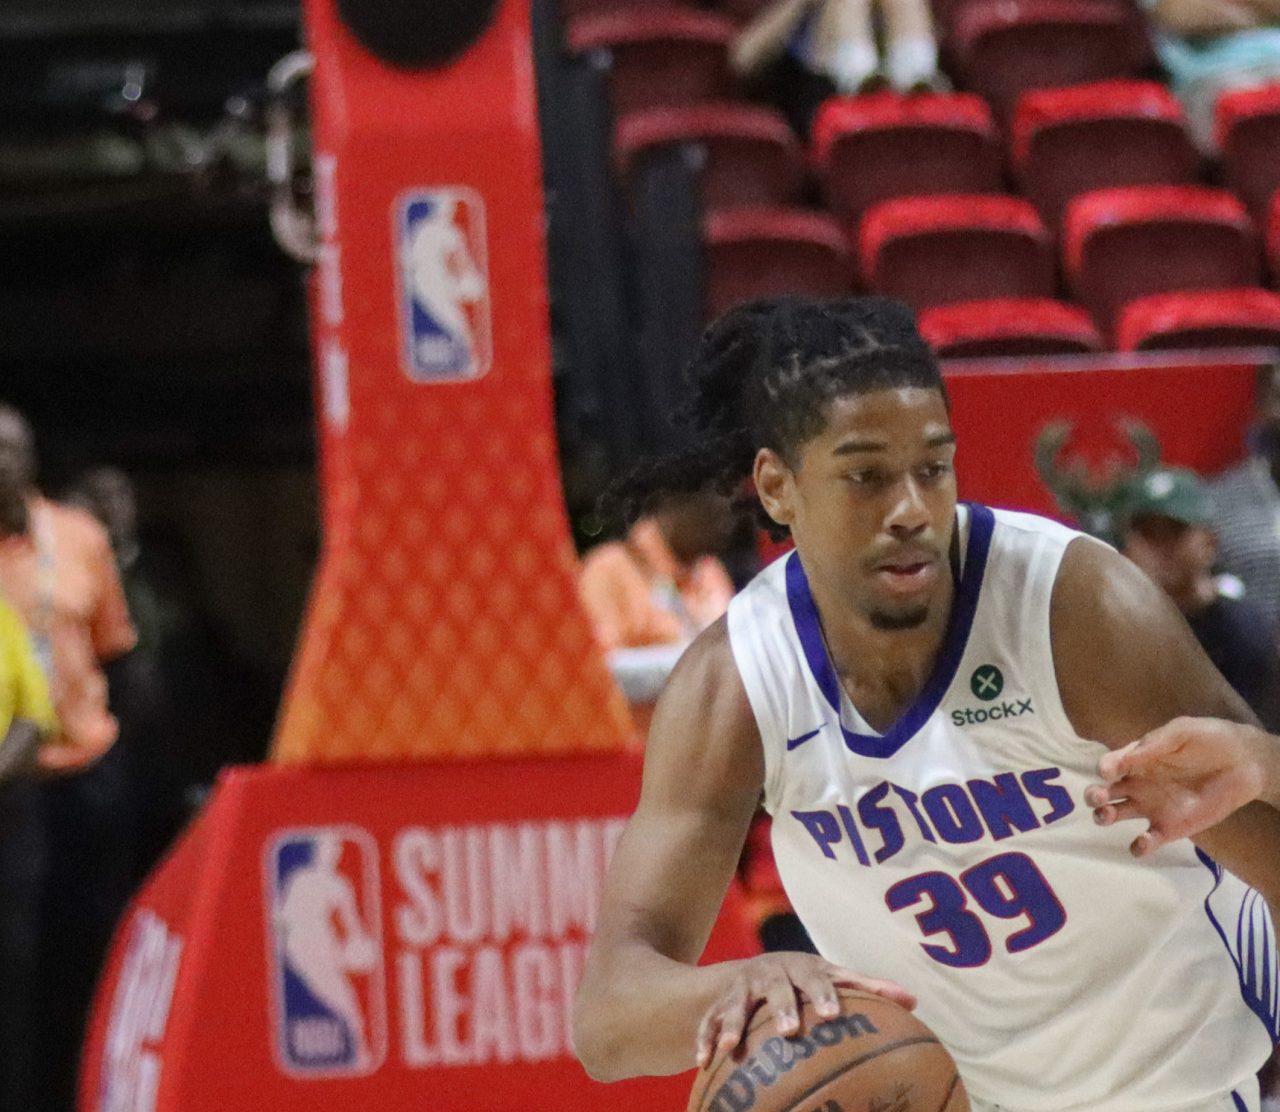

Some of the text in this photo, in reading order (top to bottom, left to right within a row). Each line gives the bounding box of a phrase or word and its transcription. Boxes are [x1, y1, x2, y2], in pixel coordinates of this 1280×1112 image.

[951, 698, 1034, 727] StockX
[790, 767, 1075, 867] PISTONS
[884, 851, 1067, 968] 39
